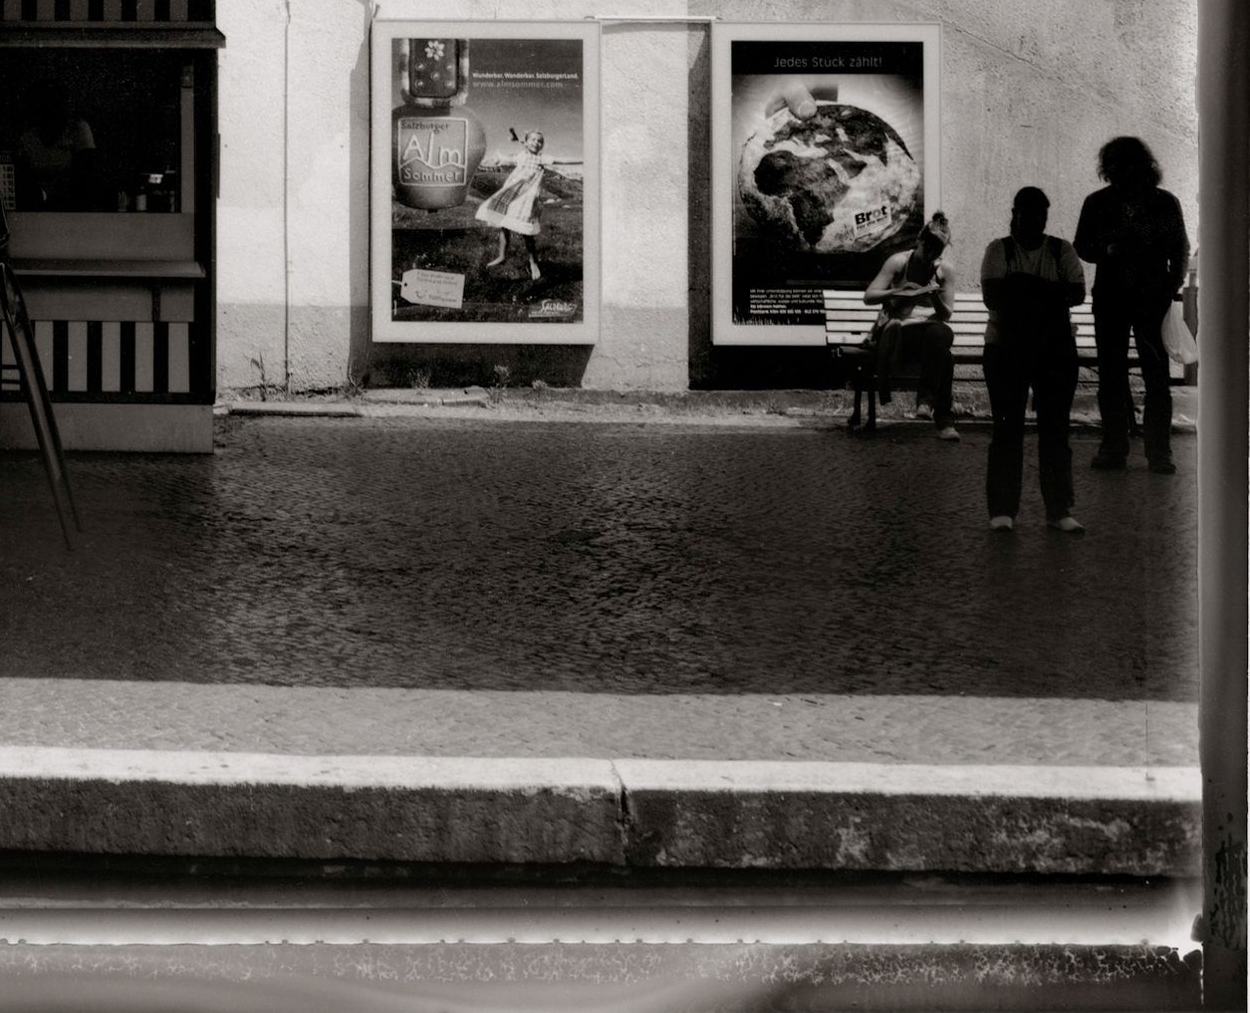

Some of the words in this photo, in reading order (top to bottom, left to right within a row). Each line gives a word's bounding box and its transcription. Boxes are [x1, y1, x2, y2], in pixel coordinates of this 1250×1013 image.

[774, 56, 808, 68] Jedes
[403, 130, 461, 167] Alm
[404, 167, 460, 182] Sommer
[854, 205, 888, 225] Brot
